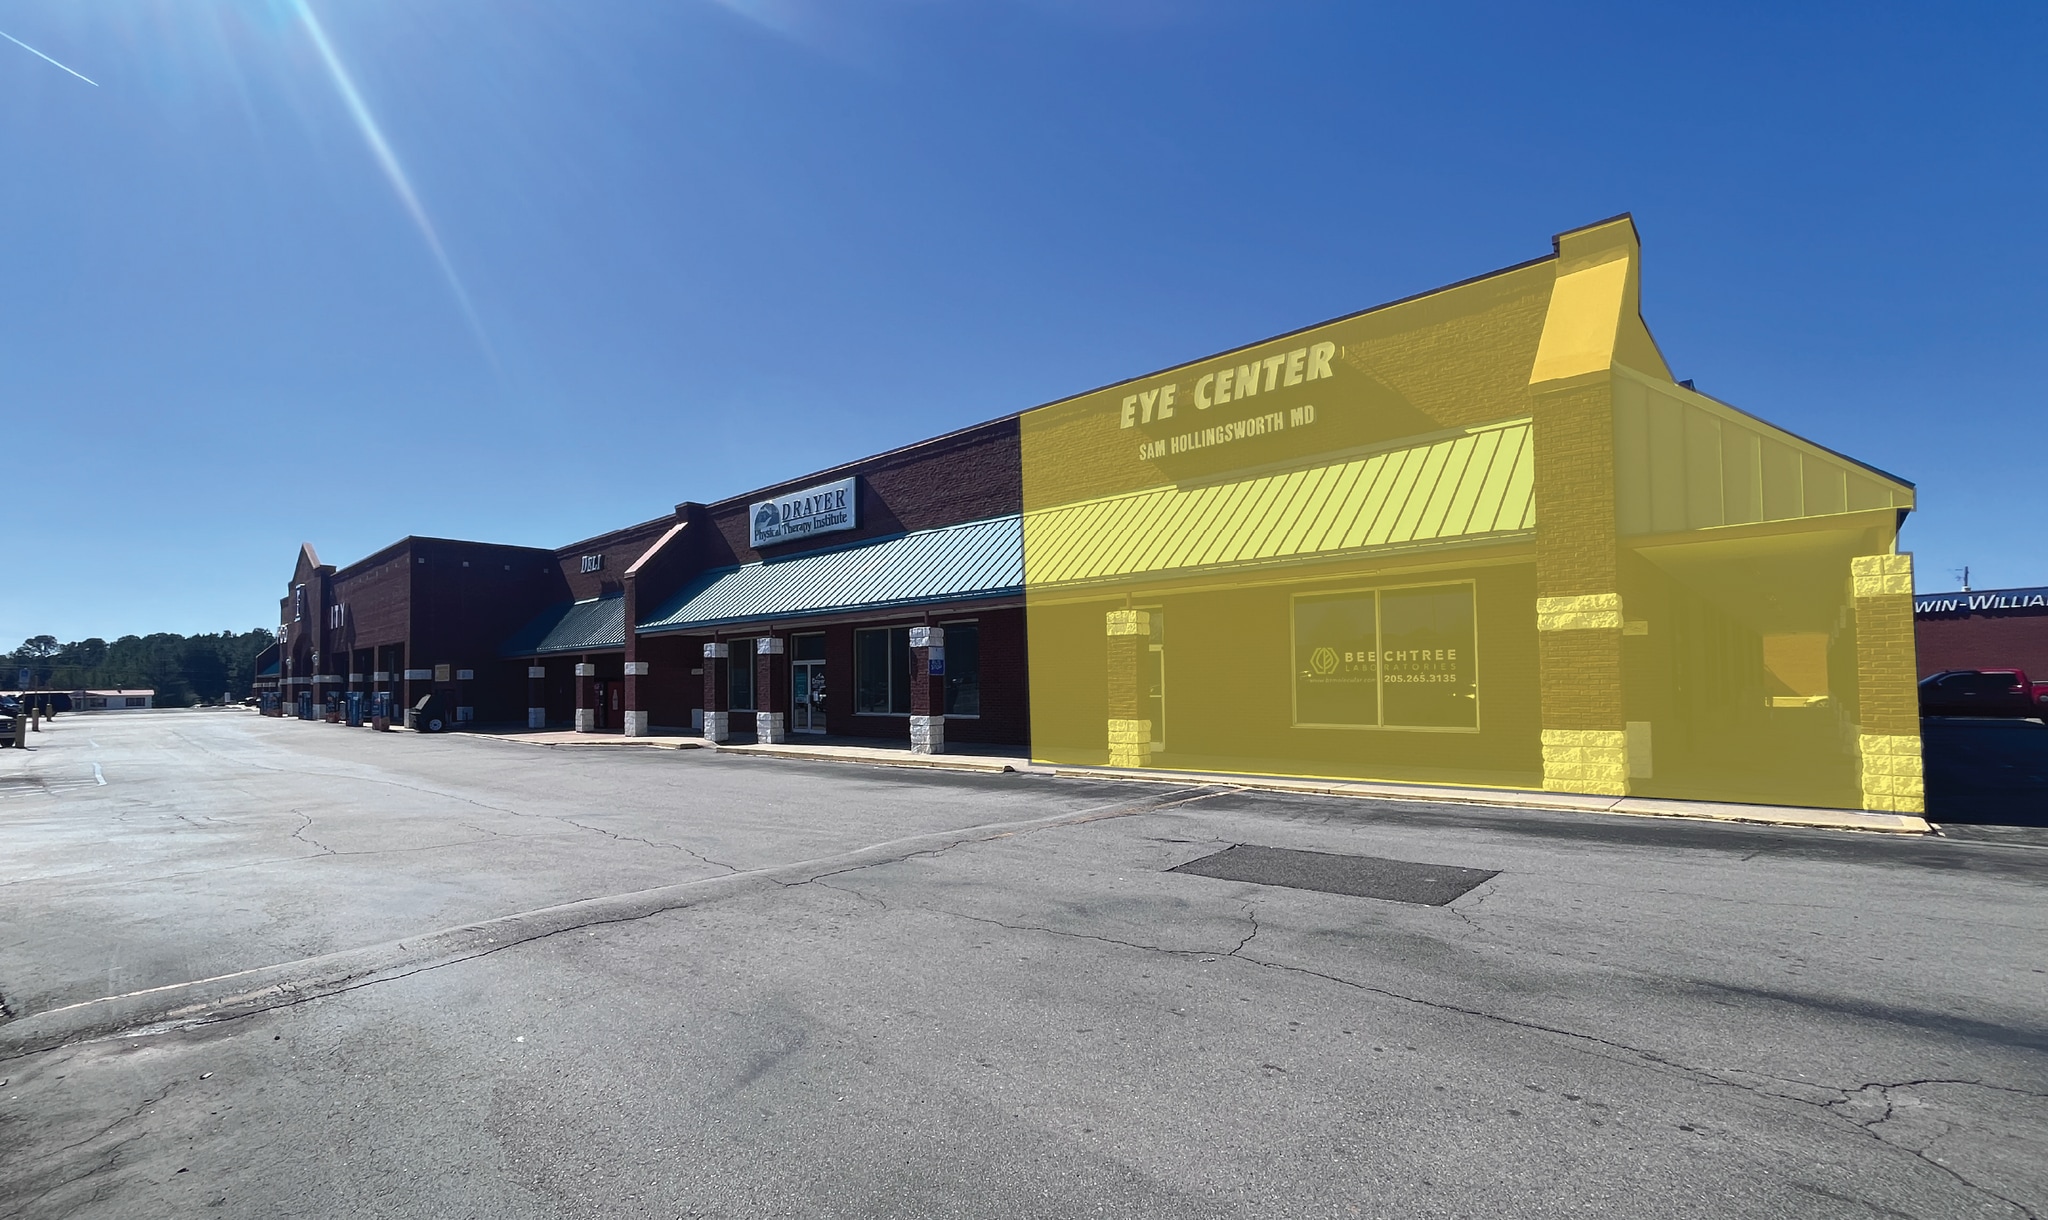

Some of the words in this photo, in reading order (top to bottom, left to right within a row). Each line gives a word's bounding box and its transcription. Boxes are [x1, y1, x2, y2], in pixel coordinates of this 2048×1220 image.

[1119, 383, 1177, 430] EYE
[1193, 341, 1336, 410] CENTER
[1138, 439, 1166, 461] SAM
[1170, 411, 1284, 454] HOLLINGSWORTH
[1290, 404, 1316, 428] MD
[781, 489, 846, 521] DRAYER
[754, 524, 781, 542] Physical
[781, 521, 812, 535] Therapy
[813, 511, 848, 529] Institute
[1344, 649, 1457, 663] BEECHTREE
[1345, 662, 1457, 672] LABORATORIES
[1383, 673, 1457, 683] 205.265.3135
